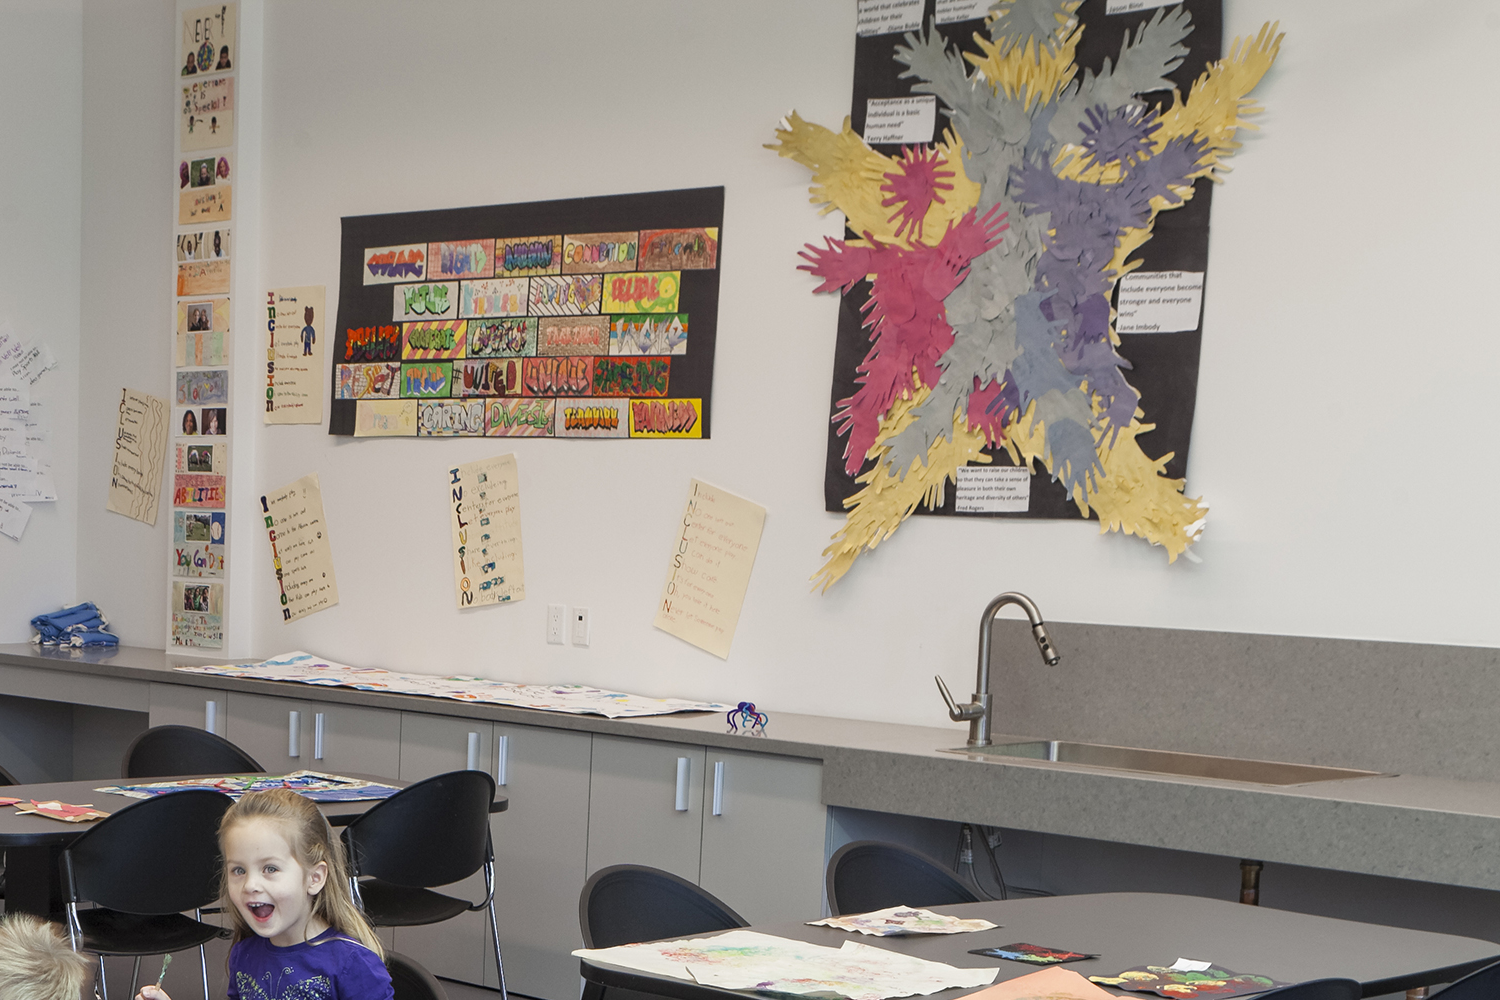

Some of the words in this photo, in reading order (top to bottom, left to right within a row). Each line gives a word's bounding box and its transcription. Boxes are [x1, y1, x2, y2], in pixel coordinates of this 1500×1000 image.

[868, 110, 895, 118] individual
[1146, 285, 1176, 293] everyone
[1162, 297, 1192, 305] everyone
[524, 357, 590, 396] UNIQUE
[422, 404, 483, 433] CARING
[174, 486, 225, 504] ABILITIES
